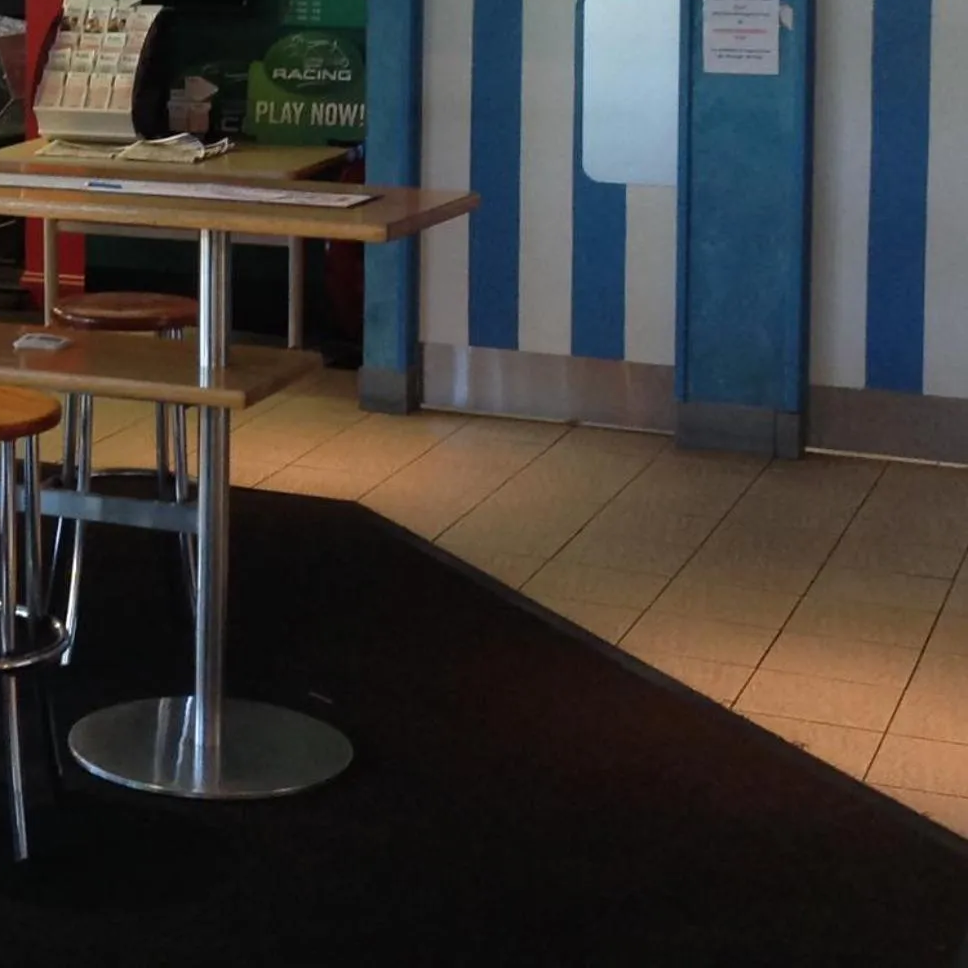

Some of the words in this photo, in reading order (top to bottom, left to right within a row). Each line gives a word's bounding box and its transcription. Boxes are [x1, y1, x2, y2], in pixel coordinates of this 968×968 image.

[272, 68, 352, 81] RACING
[255, 100, 305, 125] PLAY
[310, 102, 365, 127] NOW!
